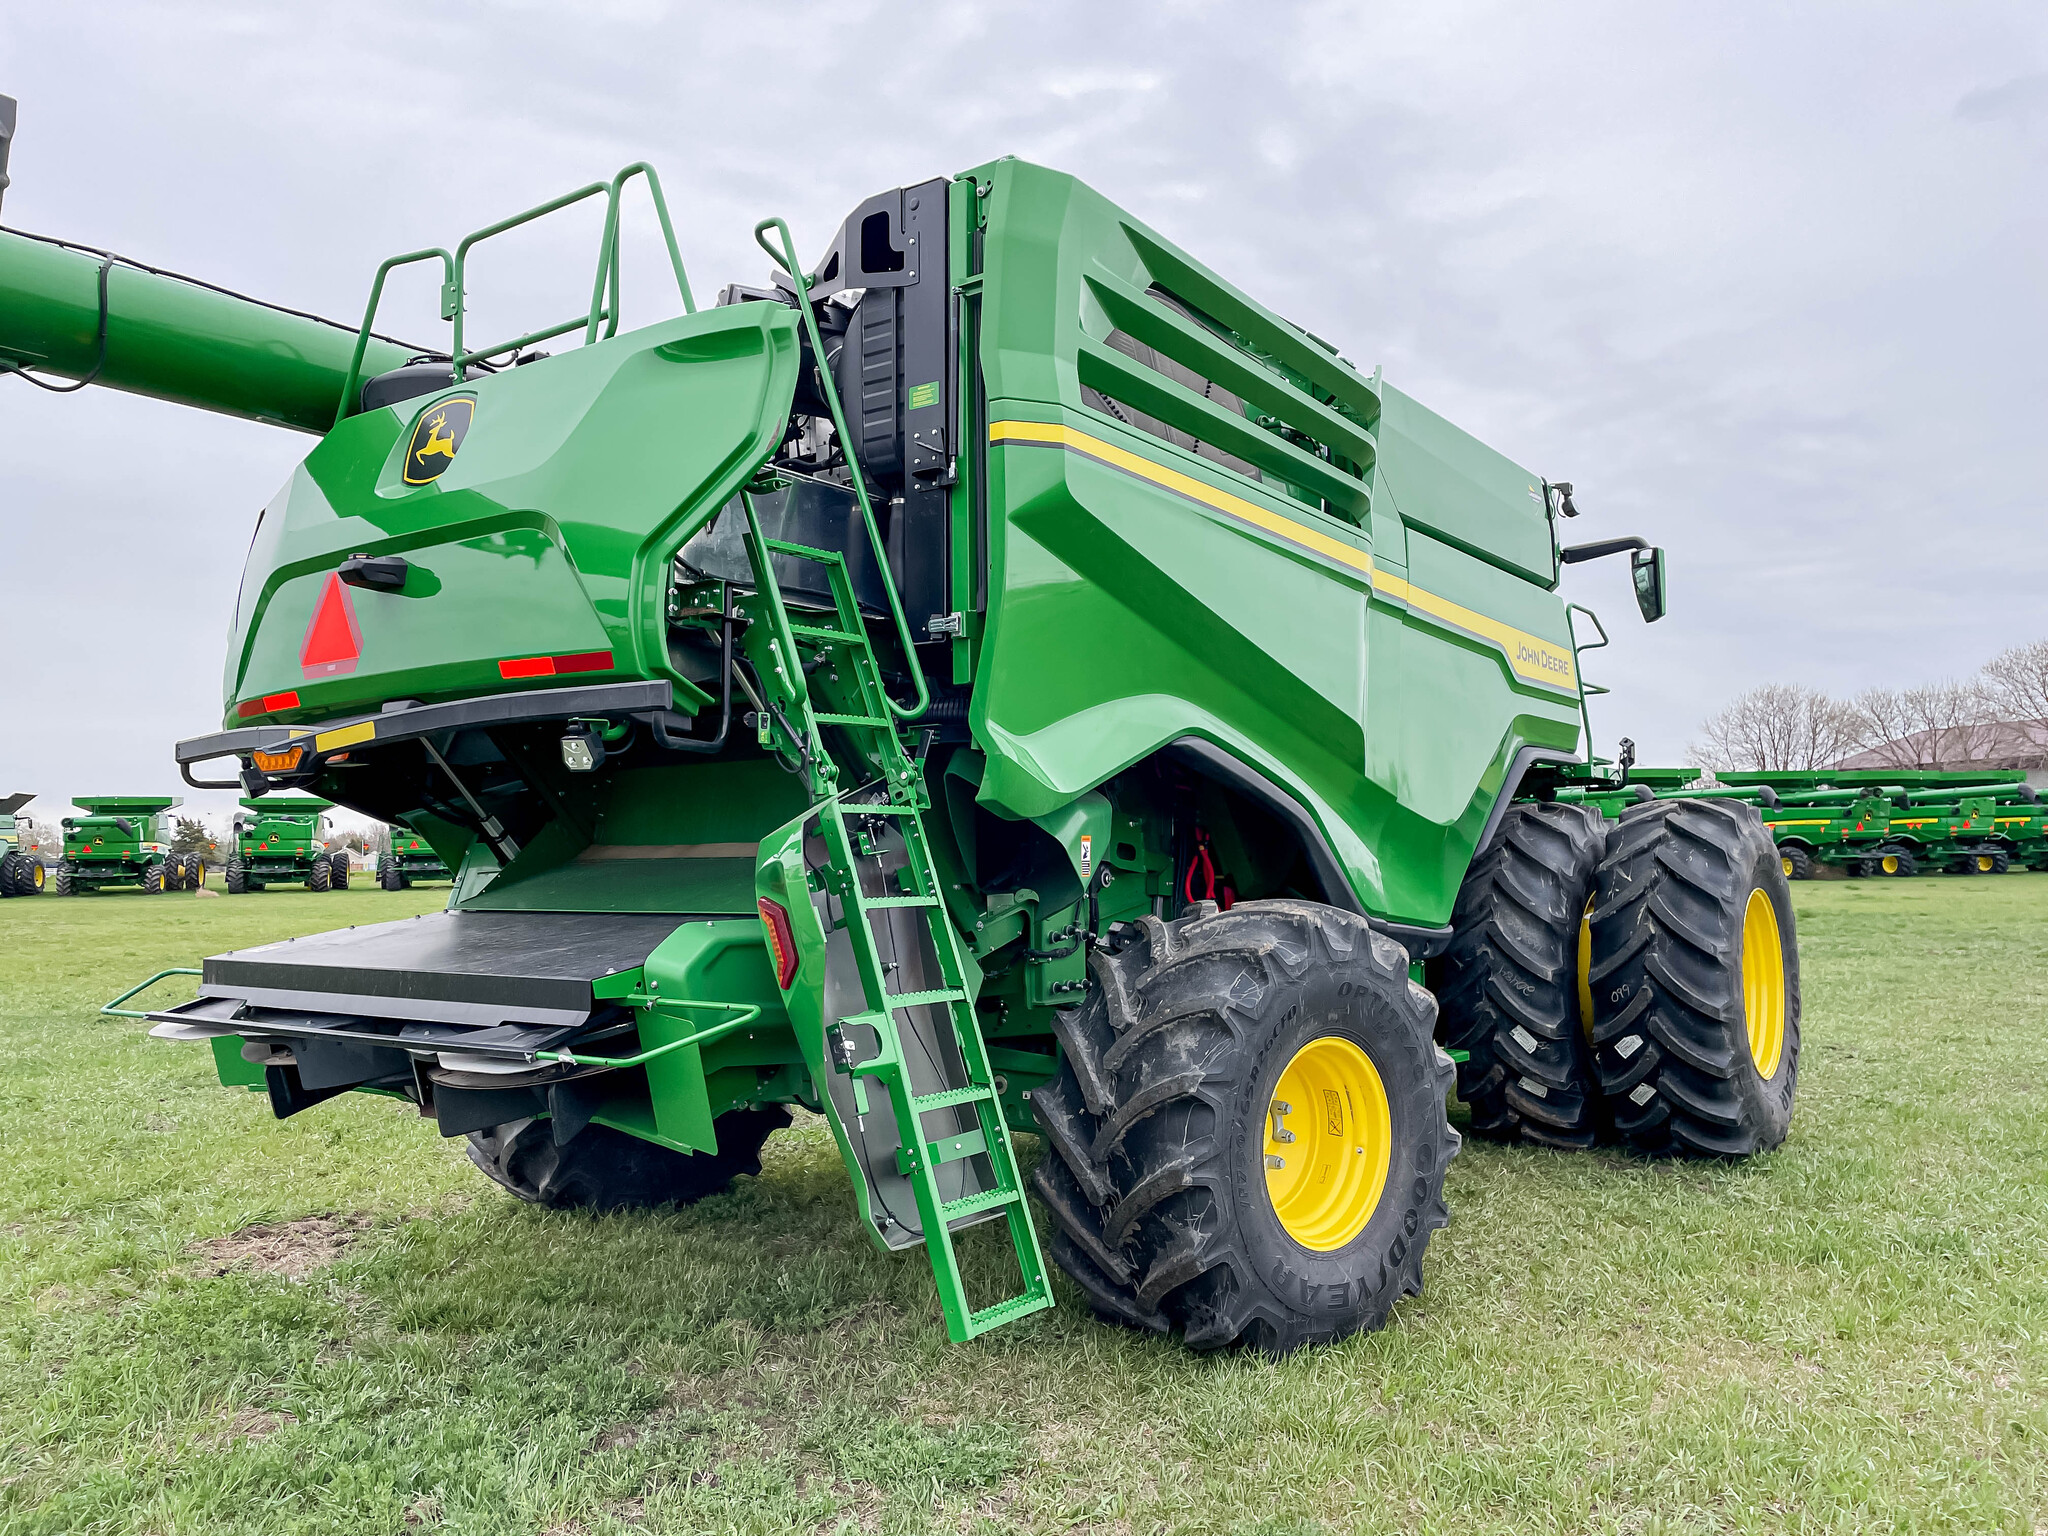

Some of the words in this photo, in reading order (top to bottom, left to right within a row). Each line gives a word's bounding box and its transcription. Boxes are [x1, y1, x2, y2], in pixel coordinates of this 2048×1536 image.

[1516, 641, 1540, 666] JOHN
[1541, 650, 1569, 676] DEERE
[1272, 1143, 1433, 1312] GOODYEAR
